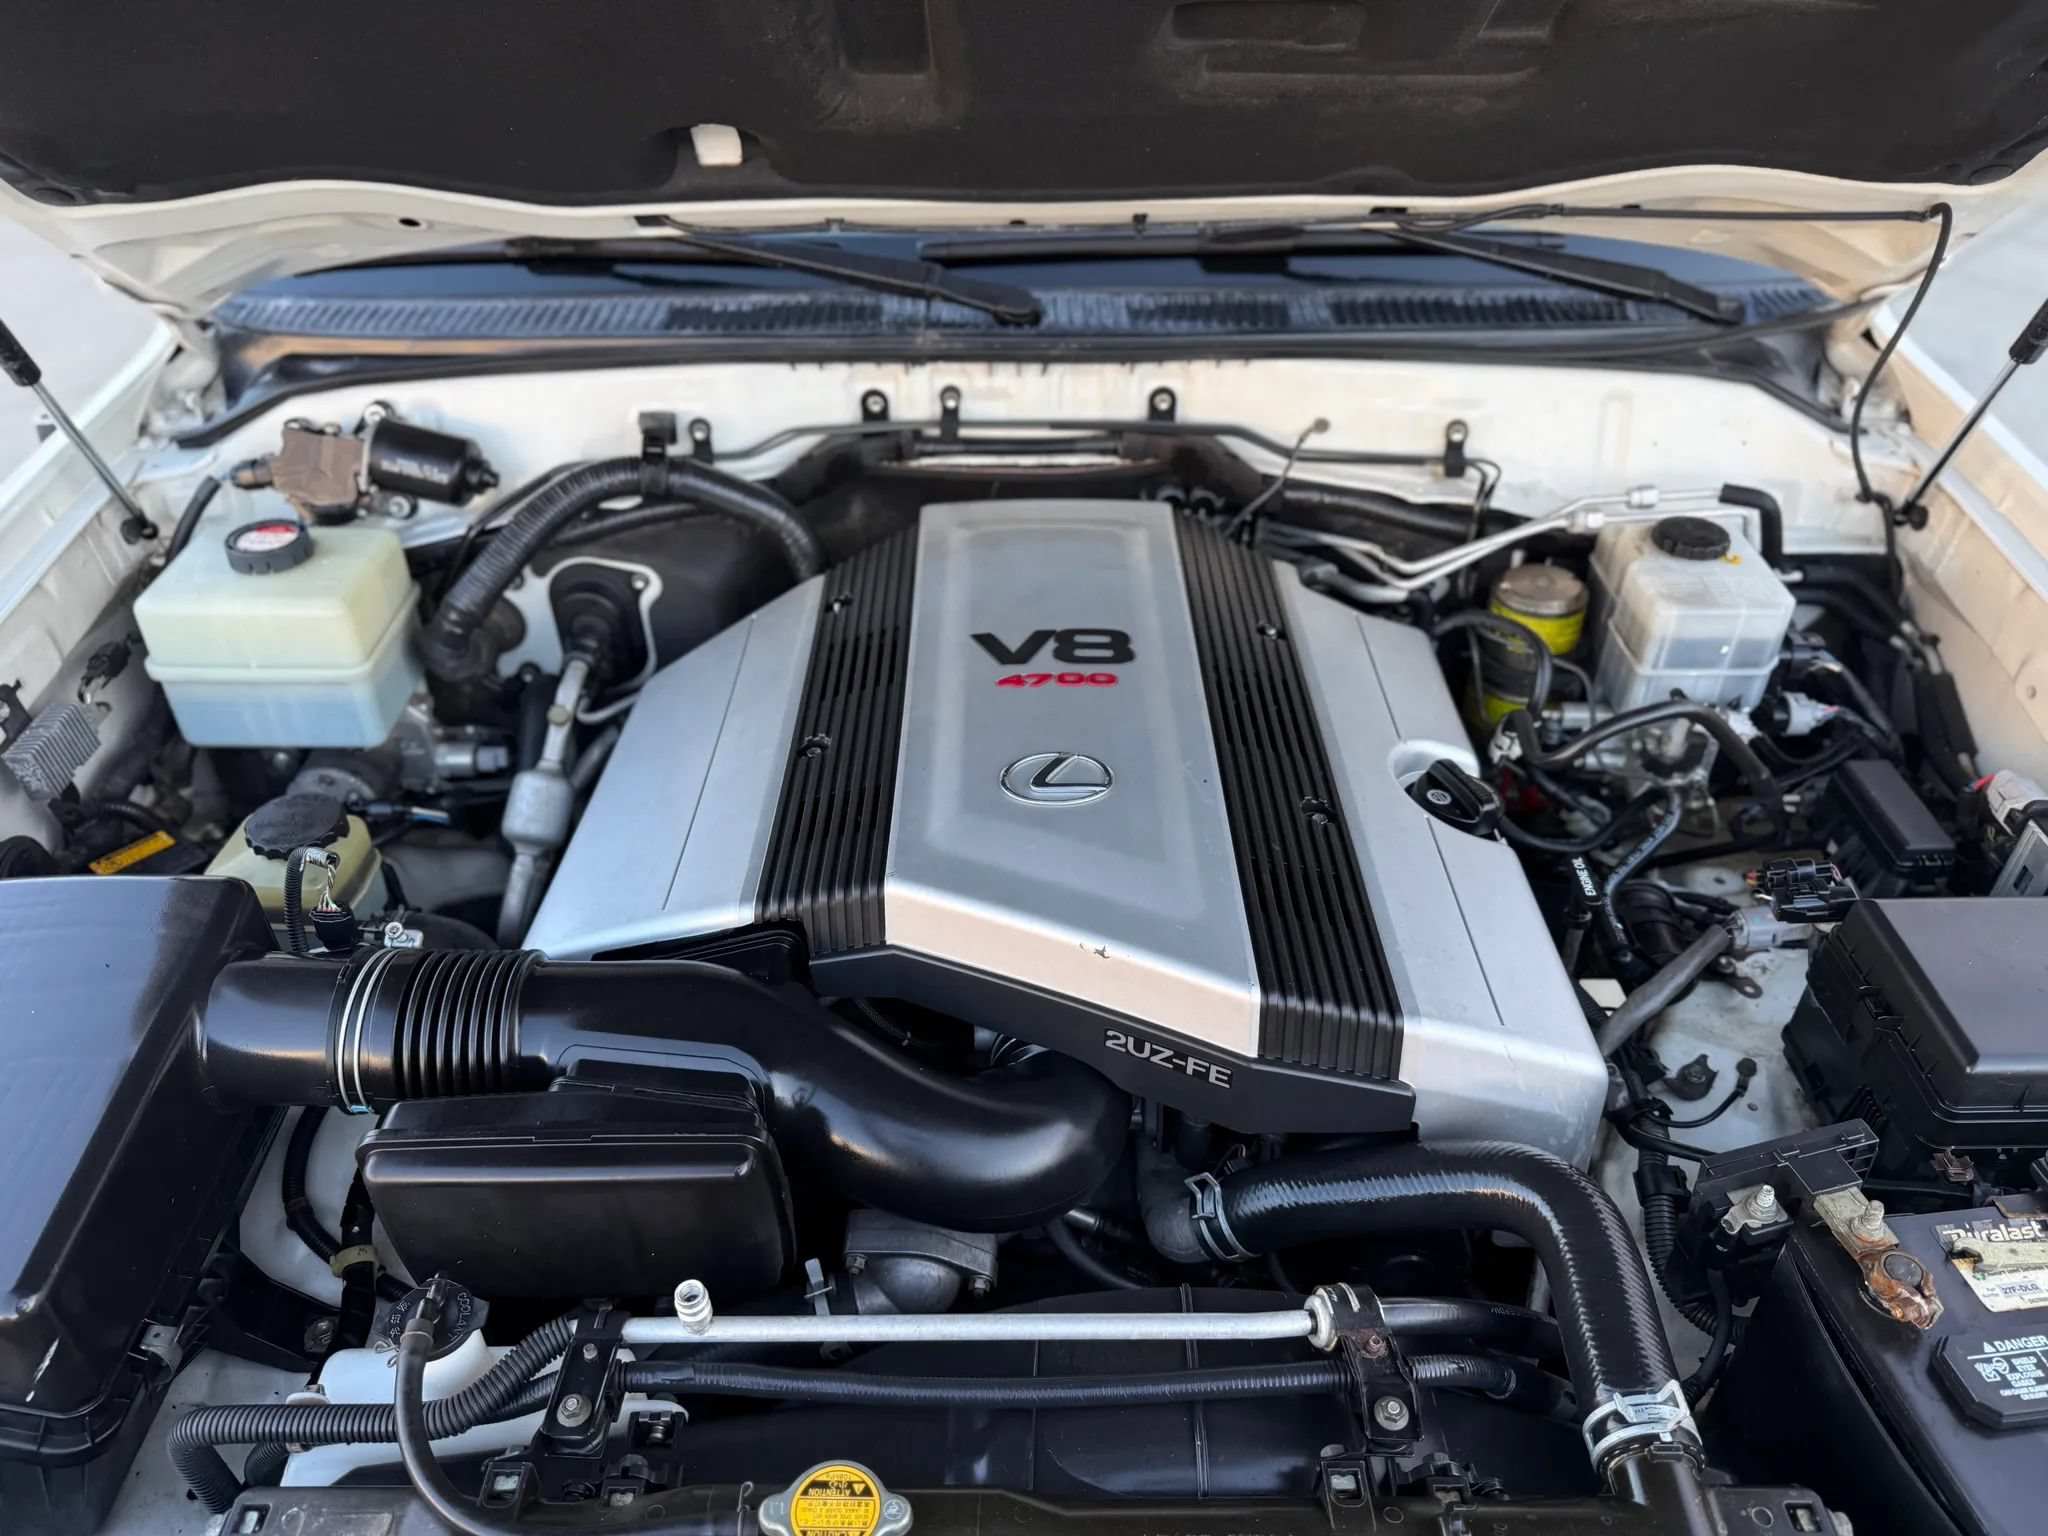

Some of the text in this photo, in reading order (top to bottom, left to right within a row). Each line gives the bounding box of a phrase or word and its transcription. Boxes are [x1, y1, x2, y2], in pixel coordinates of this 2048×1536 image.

[971, 628, 1135, 665] V8
[994, 672, 1119, 688] 4700
[1571, 856, 1597, 896] ENGINE OIL
[1105, 1029, 1232, 1089] 2UZ-FE
[1993, 1335, 2048, 1352] DANGER
[808, 1488, 852, 1496] ATTENTION
